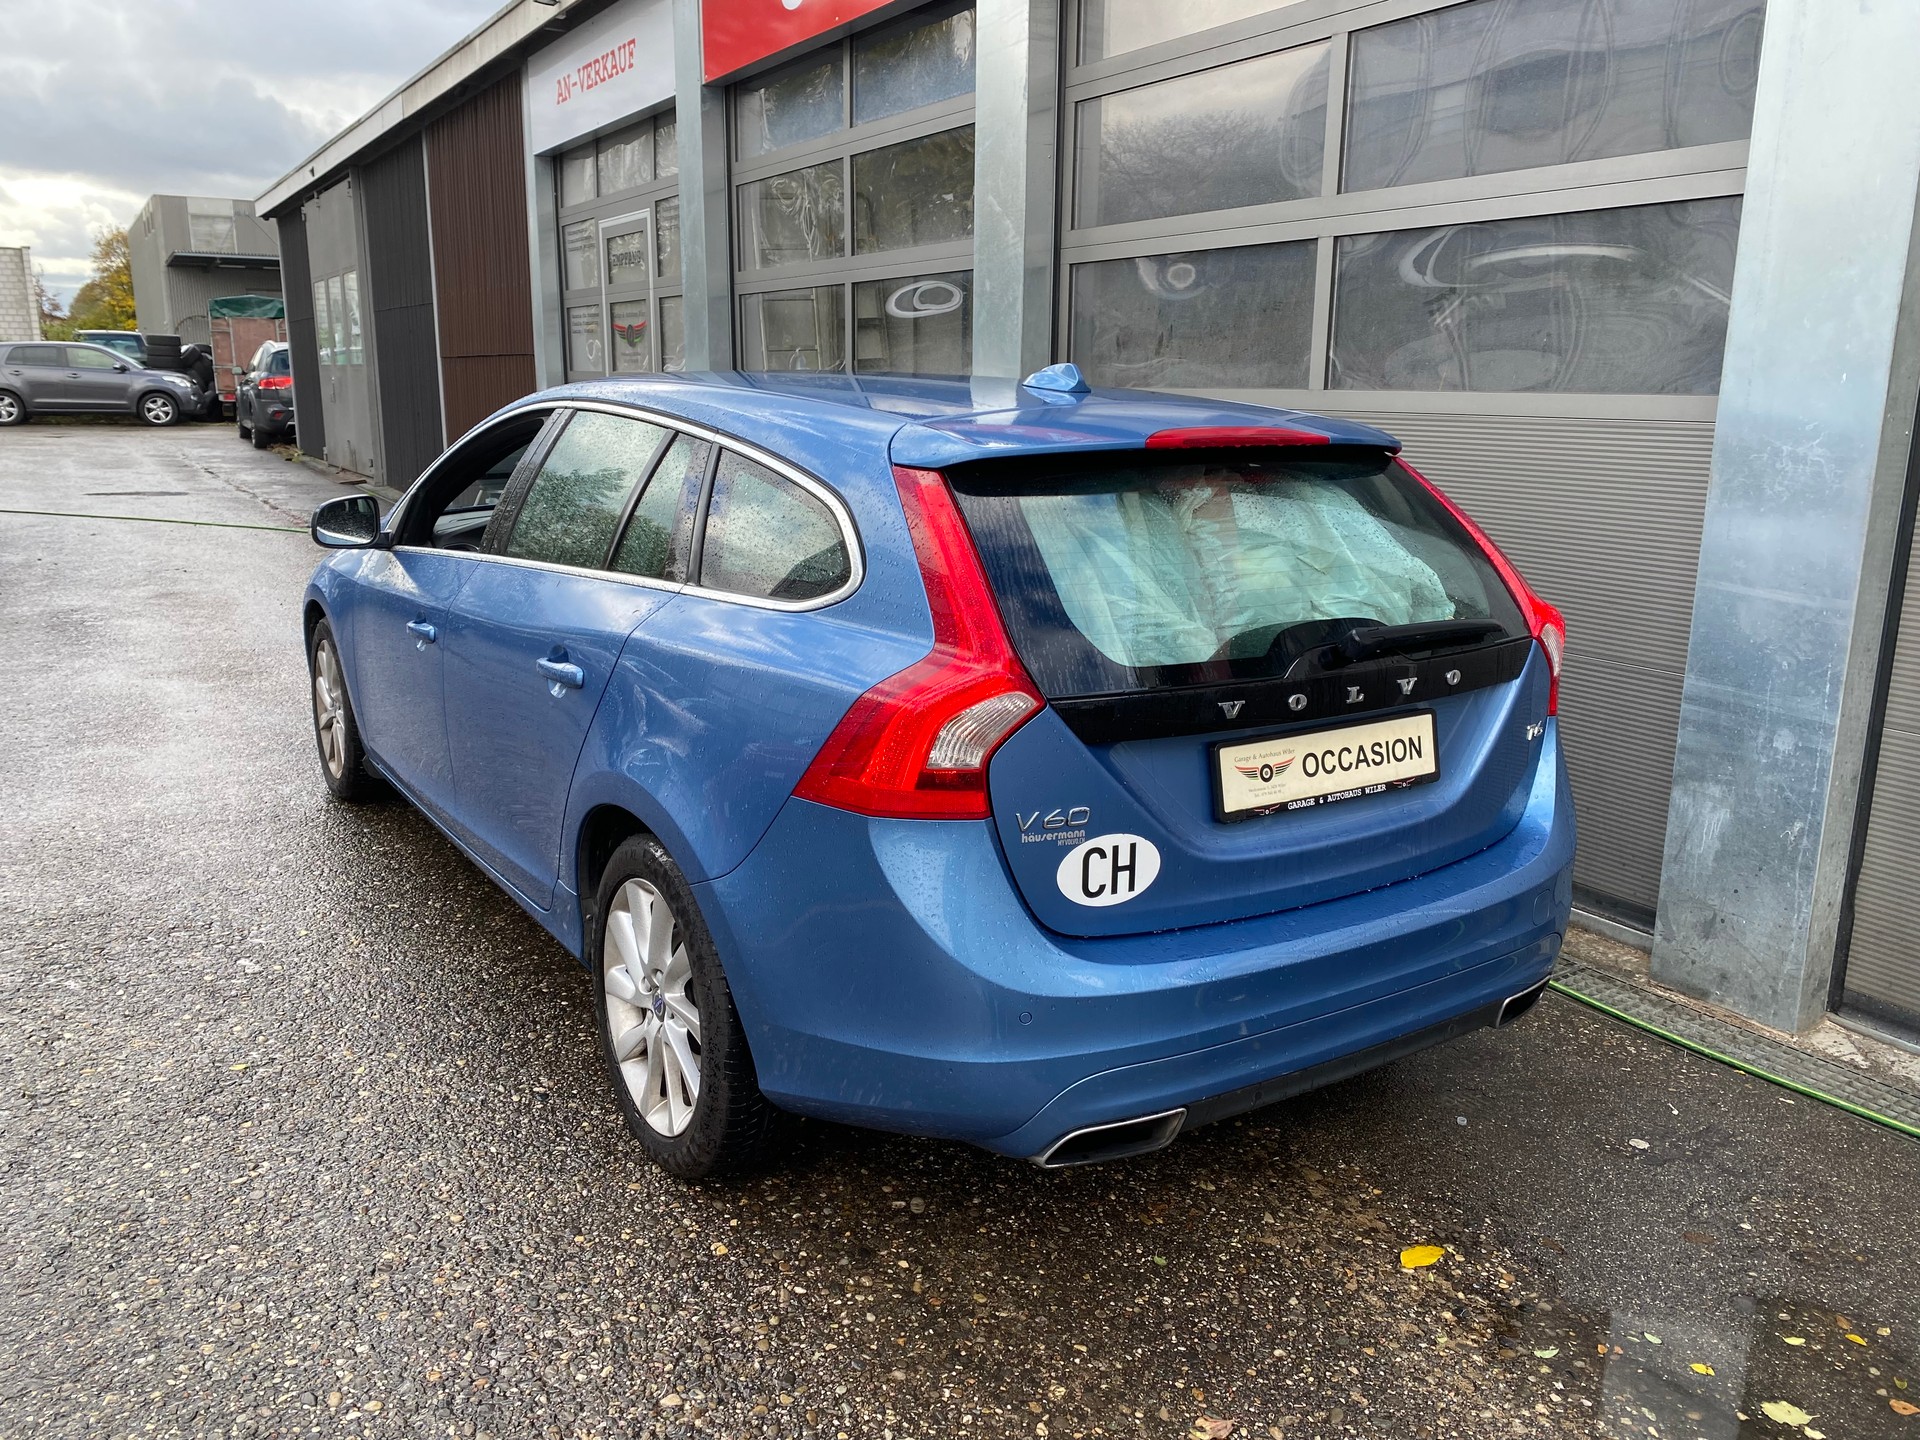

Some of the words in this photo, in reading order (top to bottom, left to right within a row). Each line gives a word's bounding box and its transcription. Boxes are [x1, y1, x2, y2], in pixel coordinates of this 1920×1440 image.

[557, 38, 635, 105] AN-VERKAUF
[1218, 669, 1461, 719] VOLVO
[1259, 751, 1282, 759] Autohaus
[1302, 735, 1423, 778] OCCASION
[1287, 798, 1316, 810] GARAGE
[1327, 789, 1362, 803] AUTOHAUS
[1365, 784, 1387, 794] WILER
[1016, 806, 1091, 832] V60
[1021, 829, 1086, 843] häusermann
[1081, 842, 1137, 899] CH
